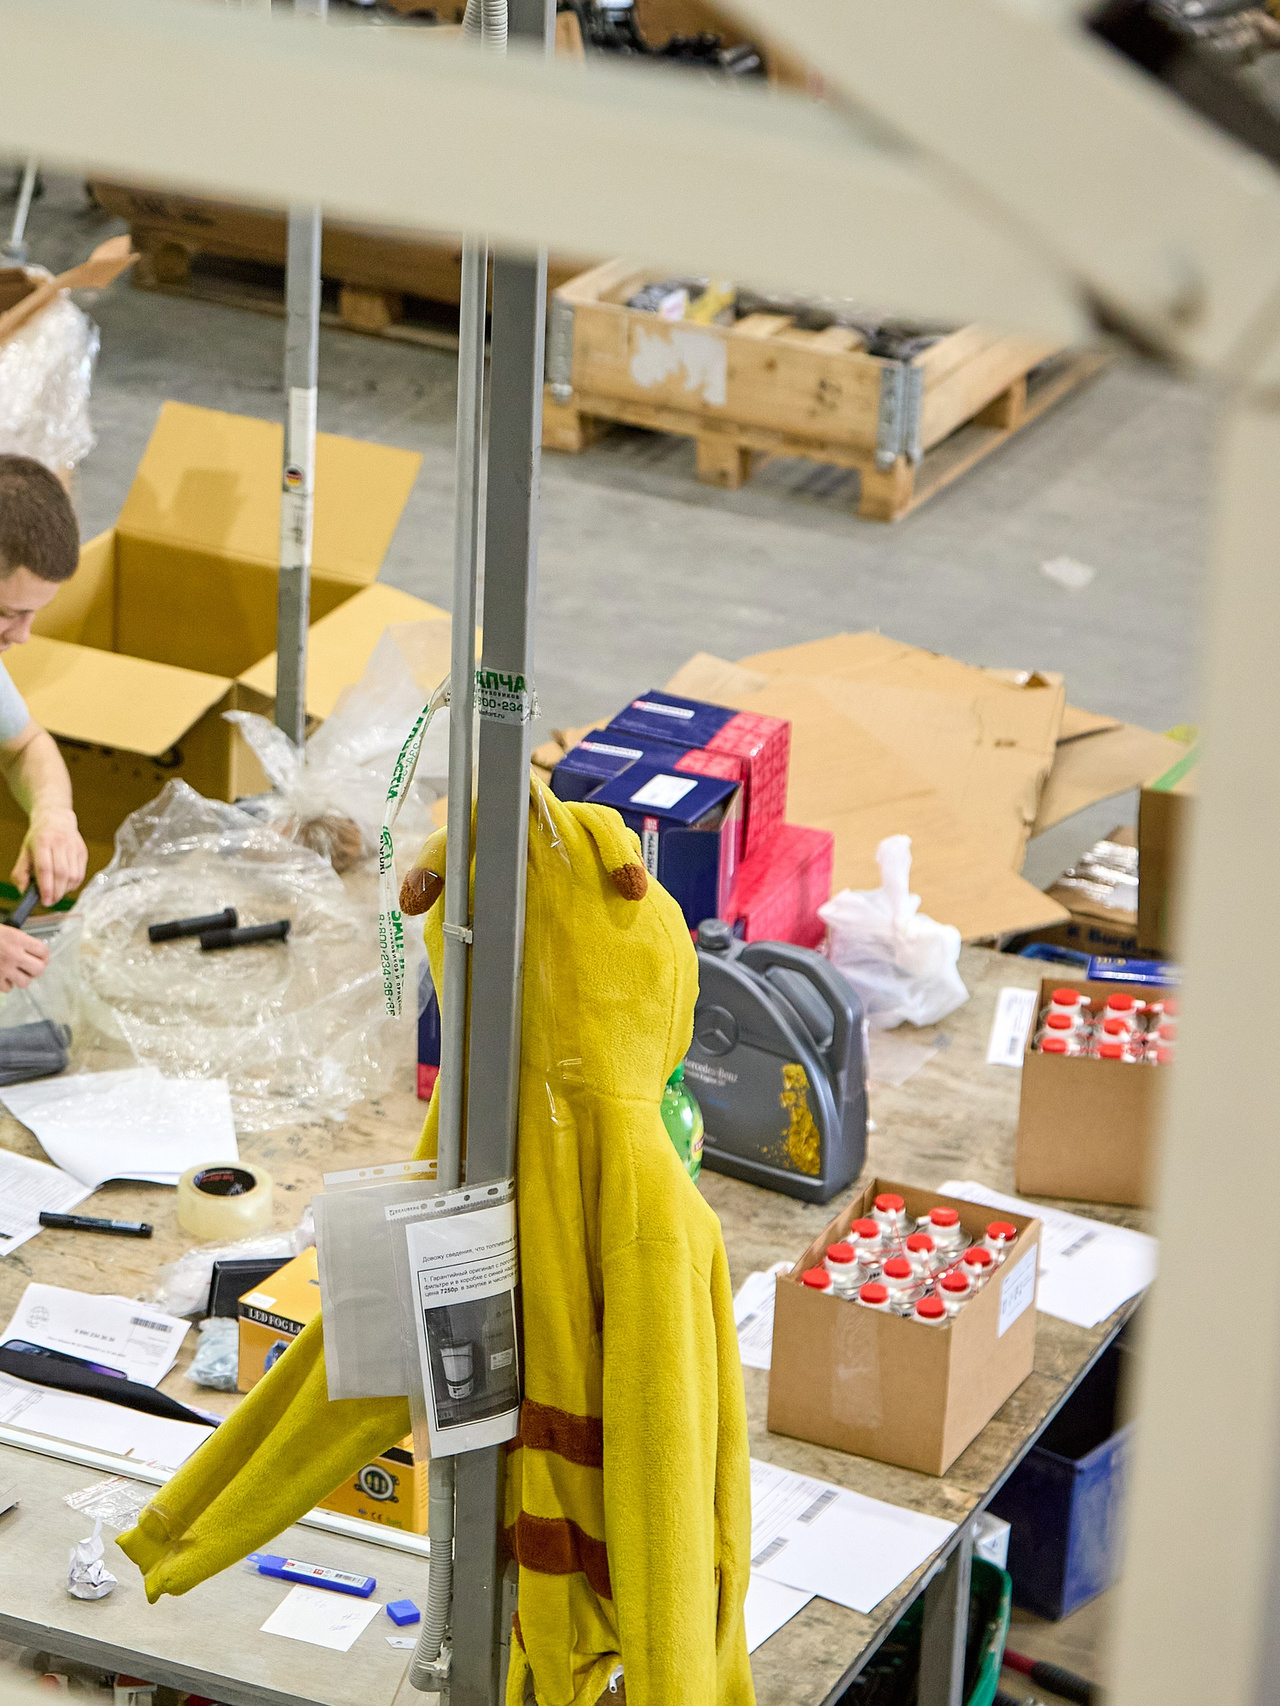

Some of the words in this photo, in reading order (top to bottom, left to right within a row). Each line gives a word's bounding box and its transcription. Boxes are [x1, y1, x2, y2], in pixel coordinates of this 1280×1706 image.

[422, 1253, 444, 1263] Довожу
[430, 1270, 468, 1282] Гарантийный
[469, 1265, 494, 1276] оригинал
[424, 1281, 449, 1290] фильтре
[460, 1274, 483, 1284] коробке
[466, 1281, 487, 1290] закупке
[248, 1308, 268, 1322] LED
[269, 1315, 288, 1330] FOG
